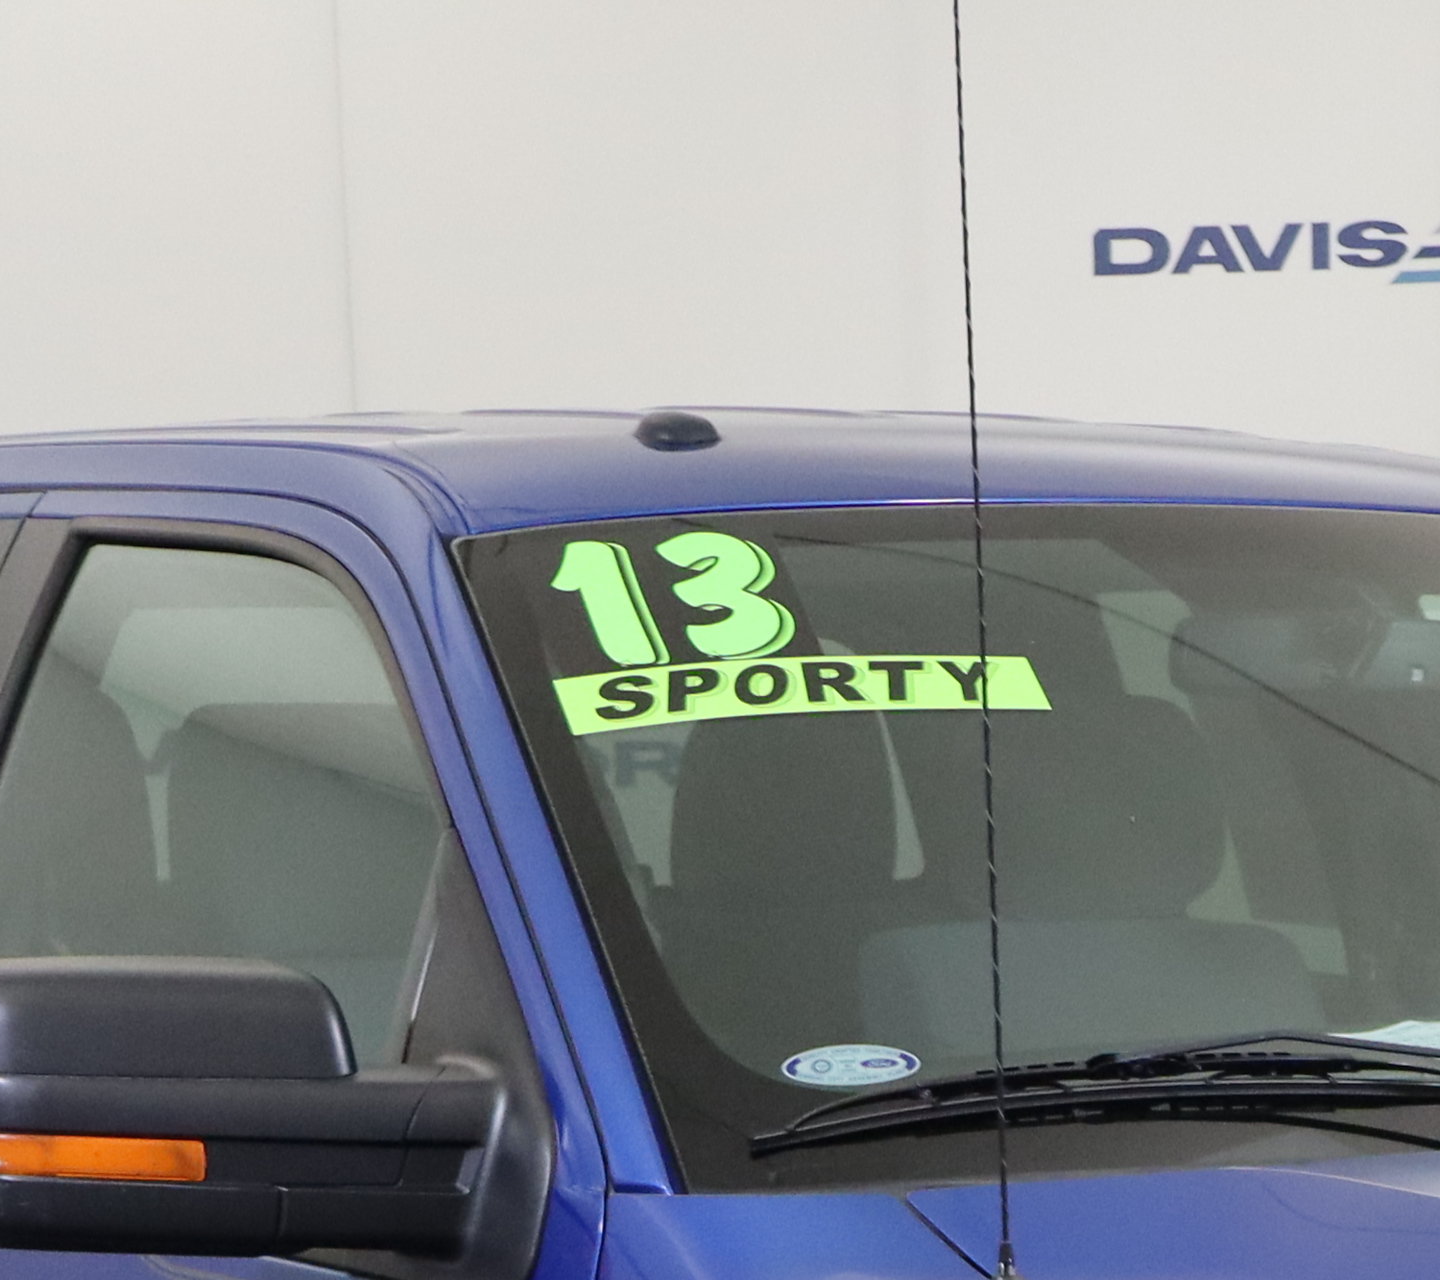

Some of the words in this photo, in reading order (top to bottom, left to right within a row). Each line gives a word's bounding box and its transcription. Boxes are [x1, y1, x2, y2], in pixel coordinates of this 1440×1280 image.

[1093, 220, 1409, 277] DAVIS
[550, 530, 796, 668] 13
[594, 660, 990, 720] SPORTY
